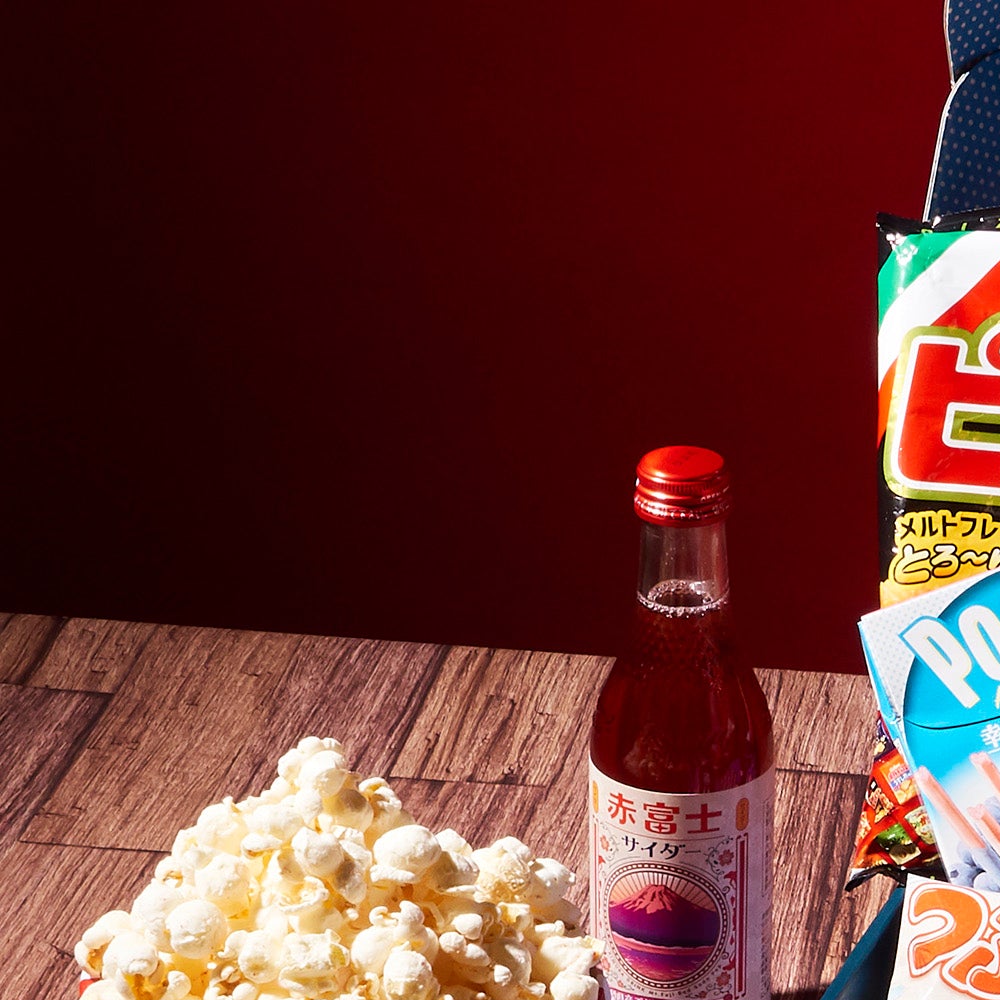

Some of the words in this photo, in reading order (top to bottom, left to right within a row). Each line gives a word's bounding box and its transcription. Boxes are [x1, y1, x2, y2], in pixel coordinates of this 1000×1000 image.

[607, 792, 723, 835] 赤富士
[620, 834, 702, 861] サイダー
